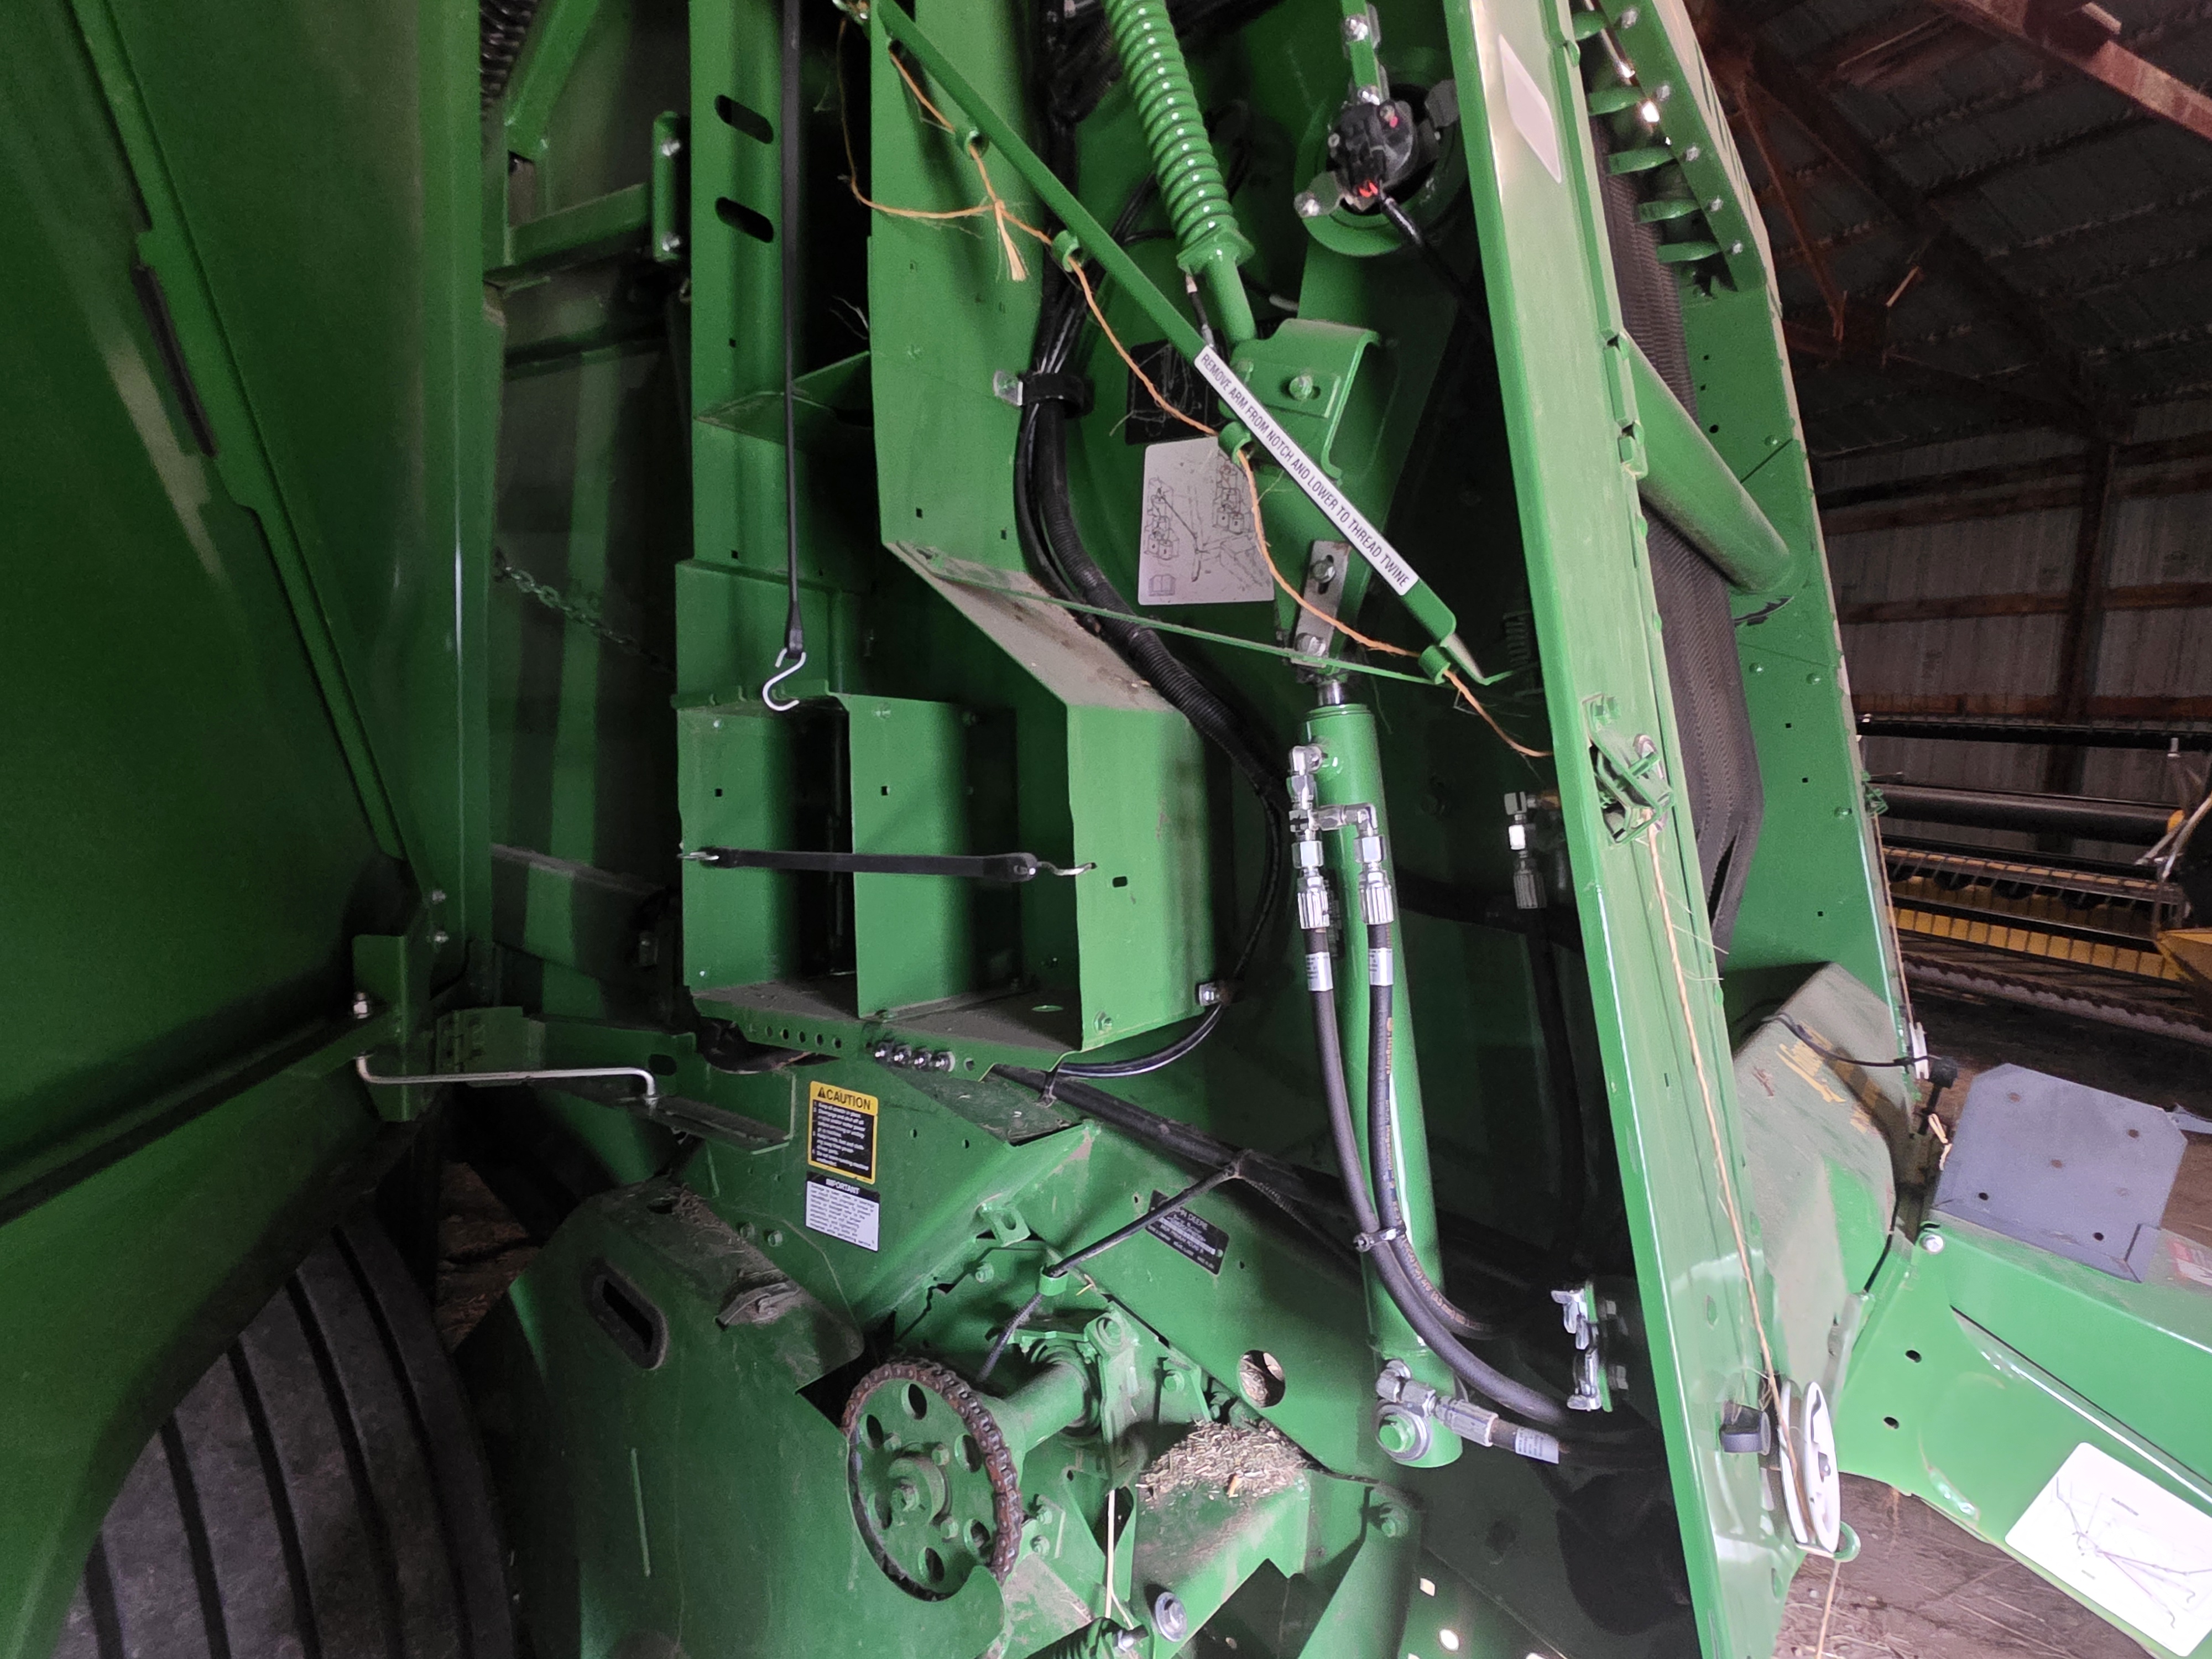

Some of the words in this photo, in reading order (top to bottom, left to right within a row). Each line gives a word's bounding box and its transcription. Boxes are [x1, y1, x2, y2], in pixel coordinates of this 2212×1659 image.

[1201, 354, 1232, 391] REMOVE
[1229, 388, 1248, 409] ARM
[1246, 406, 1270, 434] FROM
[1267, 430, 1294, 462] NOTCH
[1291, 459, 1310, 479] AND
[1308, 476, 1338, 510] LOWER
[1336, 506, 1350, 523] TO
[1348, 519, 1381, 557] THREAD
[1380, 554, 1409, 587] TWINE
[827, 1089, 870, 1110] CAUTION
